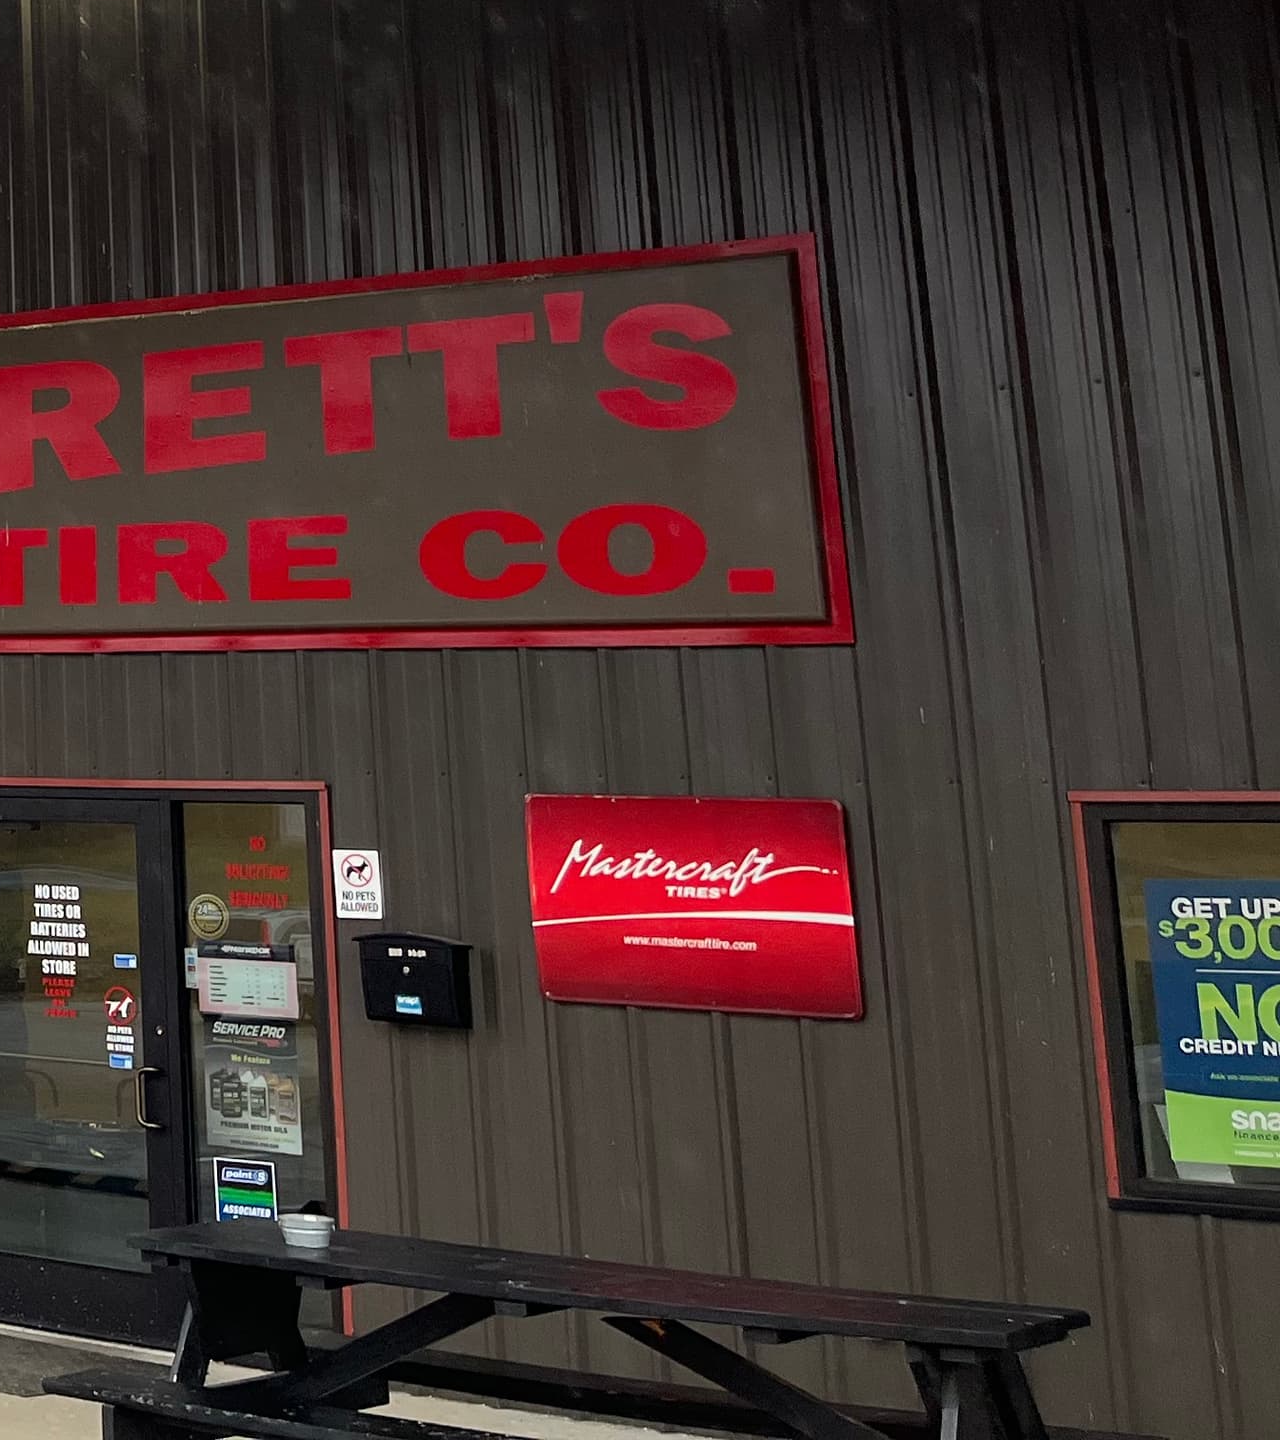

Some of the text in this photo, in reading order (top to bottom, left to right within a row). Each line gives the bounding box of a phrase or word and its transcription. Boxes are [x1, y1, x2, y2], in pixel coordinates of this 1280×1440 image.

[419, 503, 775, 601] CO.
[550, 839, 825, 897] Mastercraft
[35, 884, 80, 900] NO USED
[342, 891, 376, 902] NO PETS
[665, 885, 720, 899] TIRES
[34, 903, 81, 920] TIRES OR
[340, 902, 379, 913] ALLOWED
[1171, 897, 1280, 920] GET UP
[30, 921, 87, 938] BATTERIES
[27, 940, 90, 957] ALLOWED IN
[623, 935, 757, 951] www.mastercrafttire.com
[42, 959, 77, 975] STORE
[212, 1021, 286, 1039] SERVICE PRO
[1179, 1037, 1280, 1056] CREDIT N
[1231, 1109, 1280, 1131] sna
[225, 1169, 266, 1182] point S
[222, 1204, 272, 1218] ASSOCIATED
